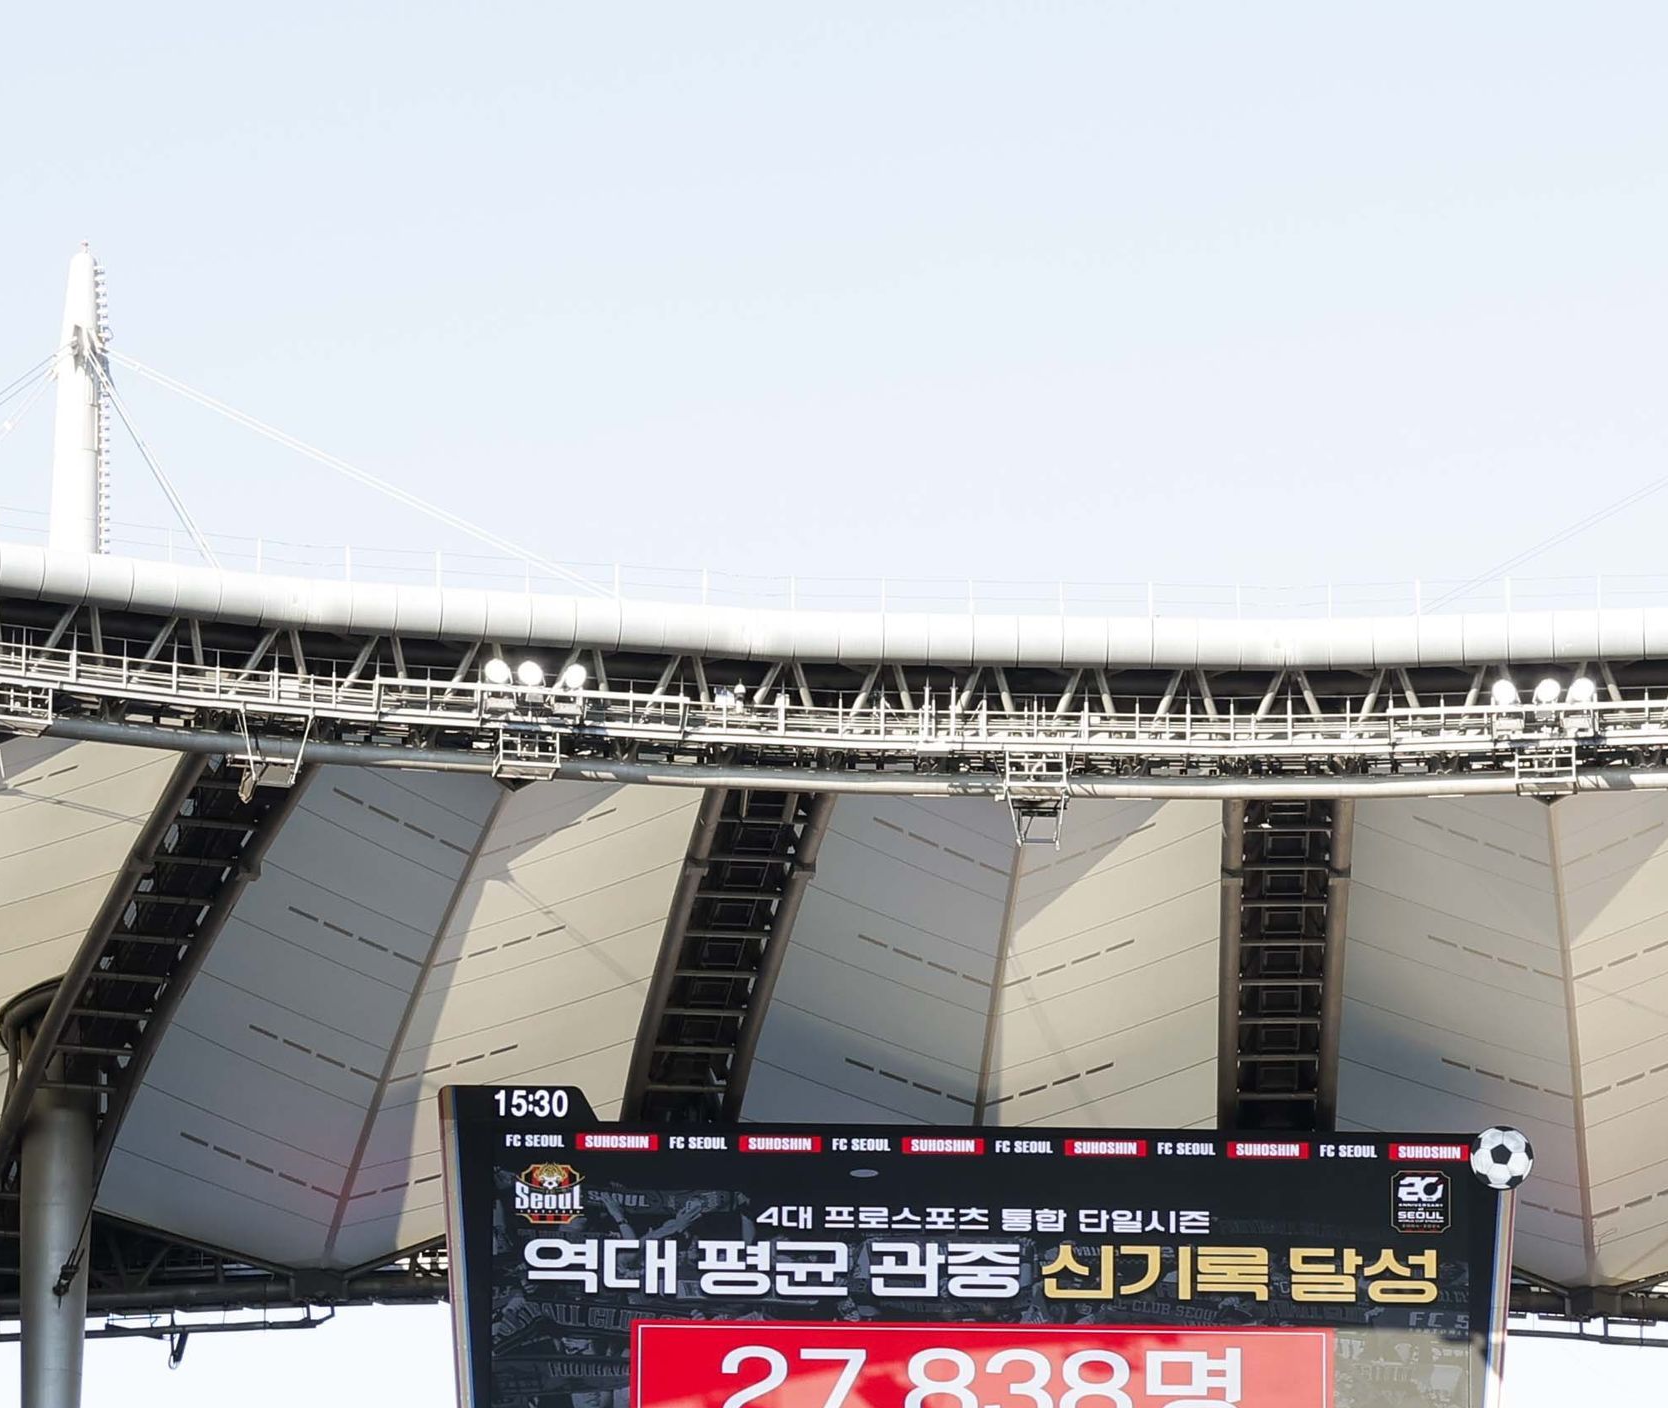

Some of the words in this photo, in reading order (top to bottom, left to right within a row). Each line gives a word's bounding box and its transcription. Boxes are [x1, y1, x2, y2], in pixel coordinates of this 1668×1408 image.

[493, 1089, 569, 1118] 15:30
[505, 1134, 522, 1148] FC
[524, 1134, 564, 1148] SEOUL
[584, 1135, 649, 1150] SUHOSHIN
[669, 1136, 685, 1150] FC
[688, 1136, 728, 1150] SEOUL
[747, 1137, 812, 1151] SUHOSHIN
[832, 1138, 848, 1152] FC
[850, 1138, 891, 1152] SEOUL
[911, 1138, 975, 1153] SUHOSHIN
[995, 1140, 1011, 1154] FC
[1013, 1140, 1053, 1154] SEOUL
[1073, 1141, 1137, 1155] SUHOSHIN
[1157, 1141, 1173, 1156] FC
[1176, 1141, 1216, 1156] SEOUL
[1235, 1143, 1300, 1157] SUHOSHIN
[1320, 1144, 1336, 1158] FC
[1338, 1144, 1378, 1158] SEOUL
[1397, 1145, 1461, 1159] SUHOSHIN
[515, 1181, 584, 1209] Seoul
[755, 1205, 813, 1229] 4대
[824, 1206, 990, 1231] 프로스포츠
[1001, 1208, 1067, 1233] 통합
[1078, 1208, 1210, 1235] 단일시즌
[1397, 1211, 1444, 1219] SEOUL
[523, 1238, 677, 1294] 역대
[697, 1239, 848, 1297] 평균
[869, 1241, 1021, 1299] 관중
[1041, 1244, 1270, 1301] 신기록
[1290, 1247, 1439, 1304] 달성
